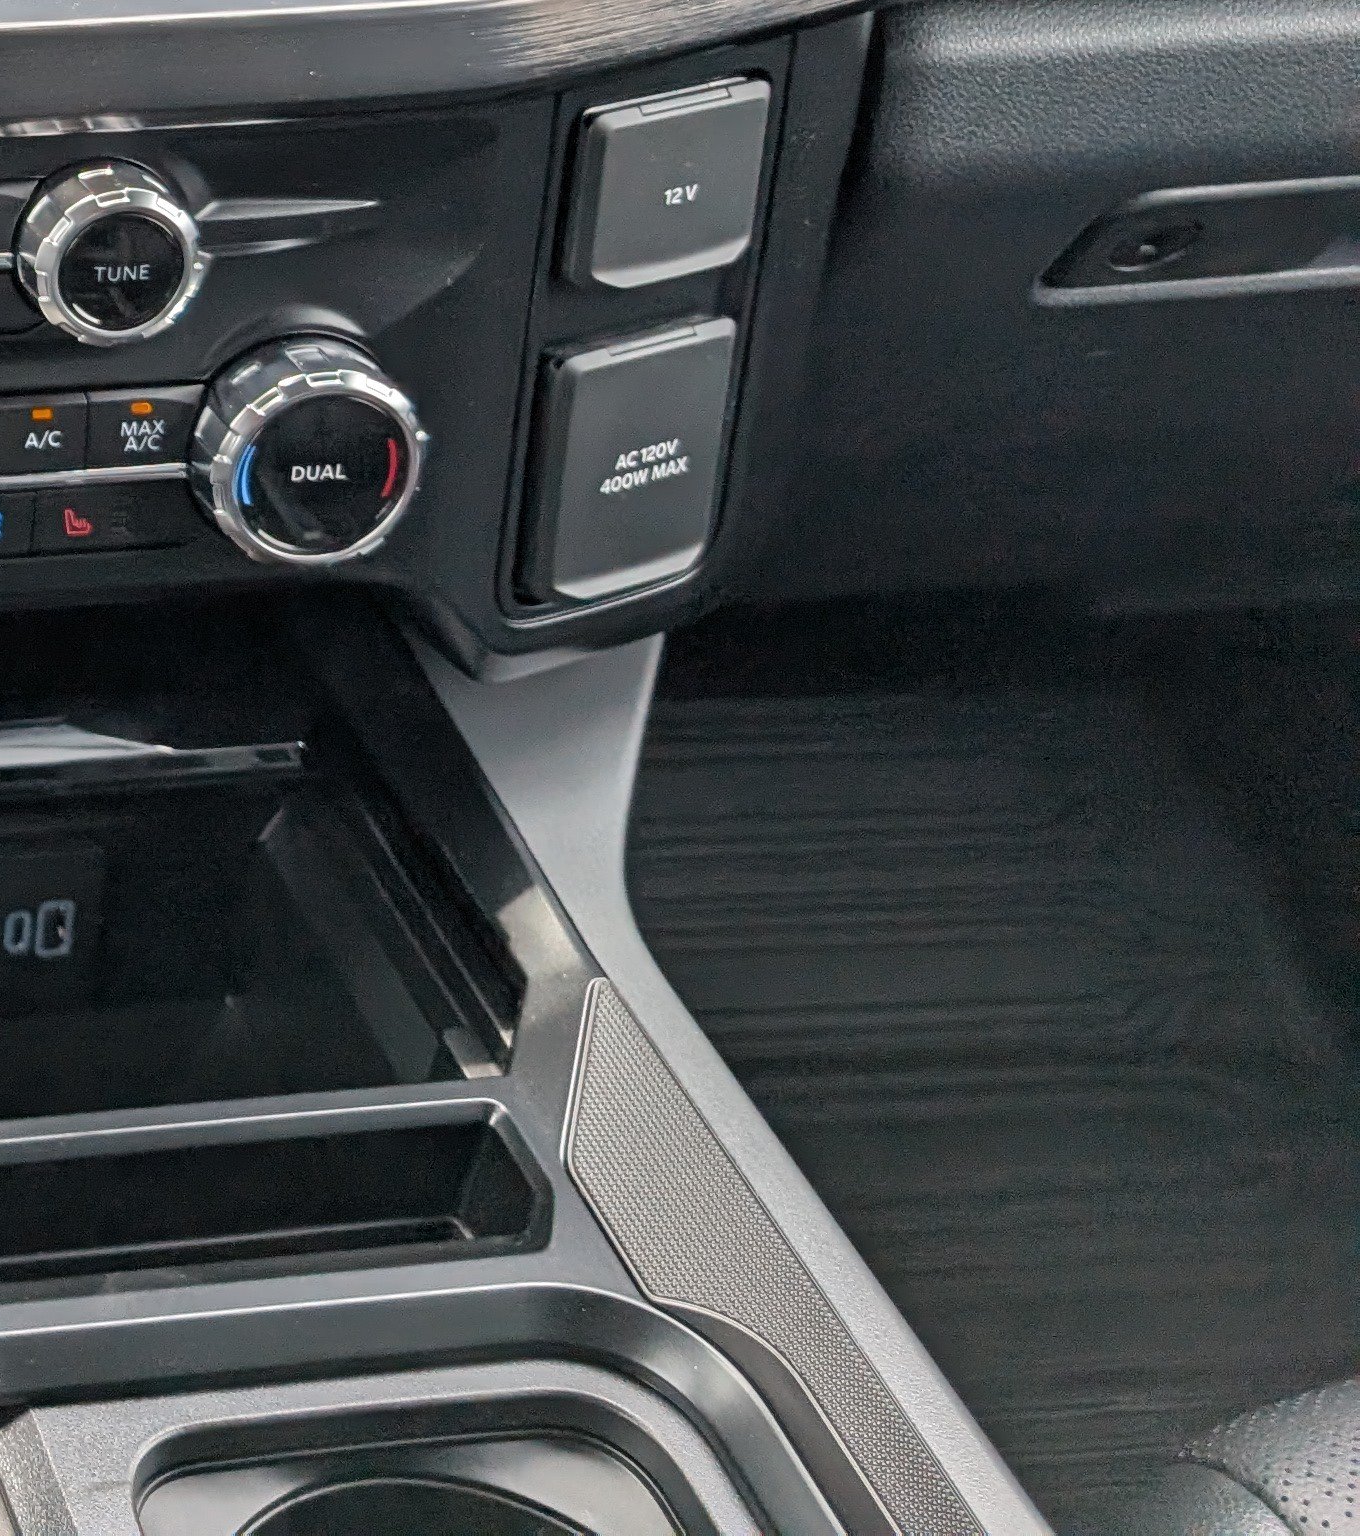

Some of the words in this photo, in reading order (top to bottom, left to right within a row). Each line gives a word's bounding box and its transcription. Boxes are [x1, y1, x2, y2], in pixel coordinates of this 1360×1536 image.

[664, 187, 683, 206] 12
[93, 264, 151, 283] TUNE
[121, 419, 166, 437] MAX
[24, 430, 63, 449] A/C
[124, 434, 164, 452] A/C
[614, 449, 640, 470] AC
[641, 437, 679, 464] 120V
[290, 464, 350, 483] DUAL
[599, 468, 649, 494] 400W
[651, 455, 688, 481] MAX
